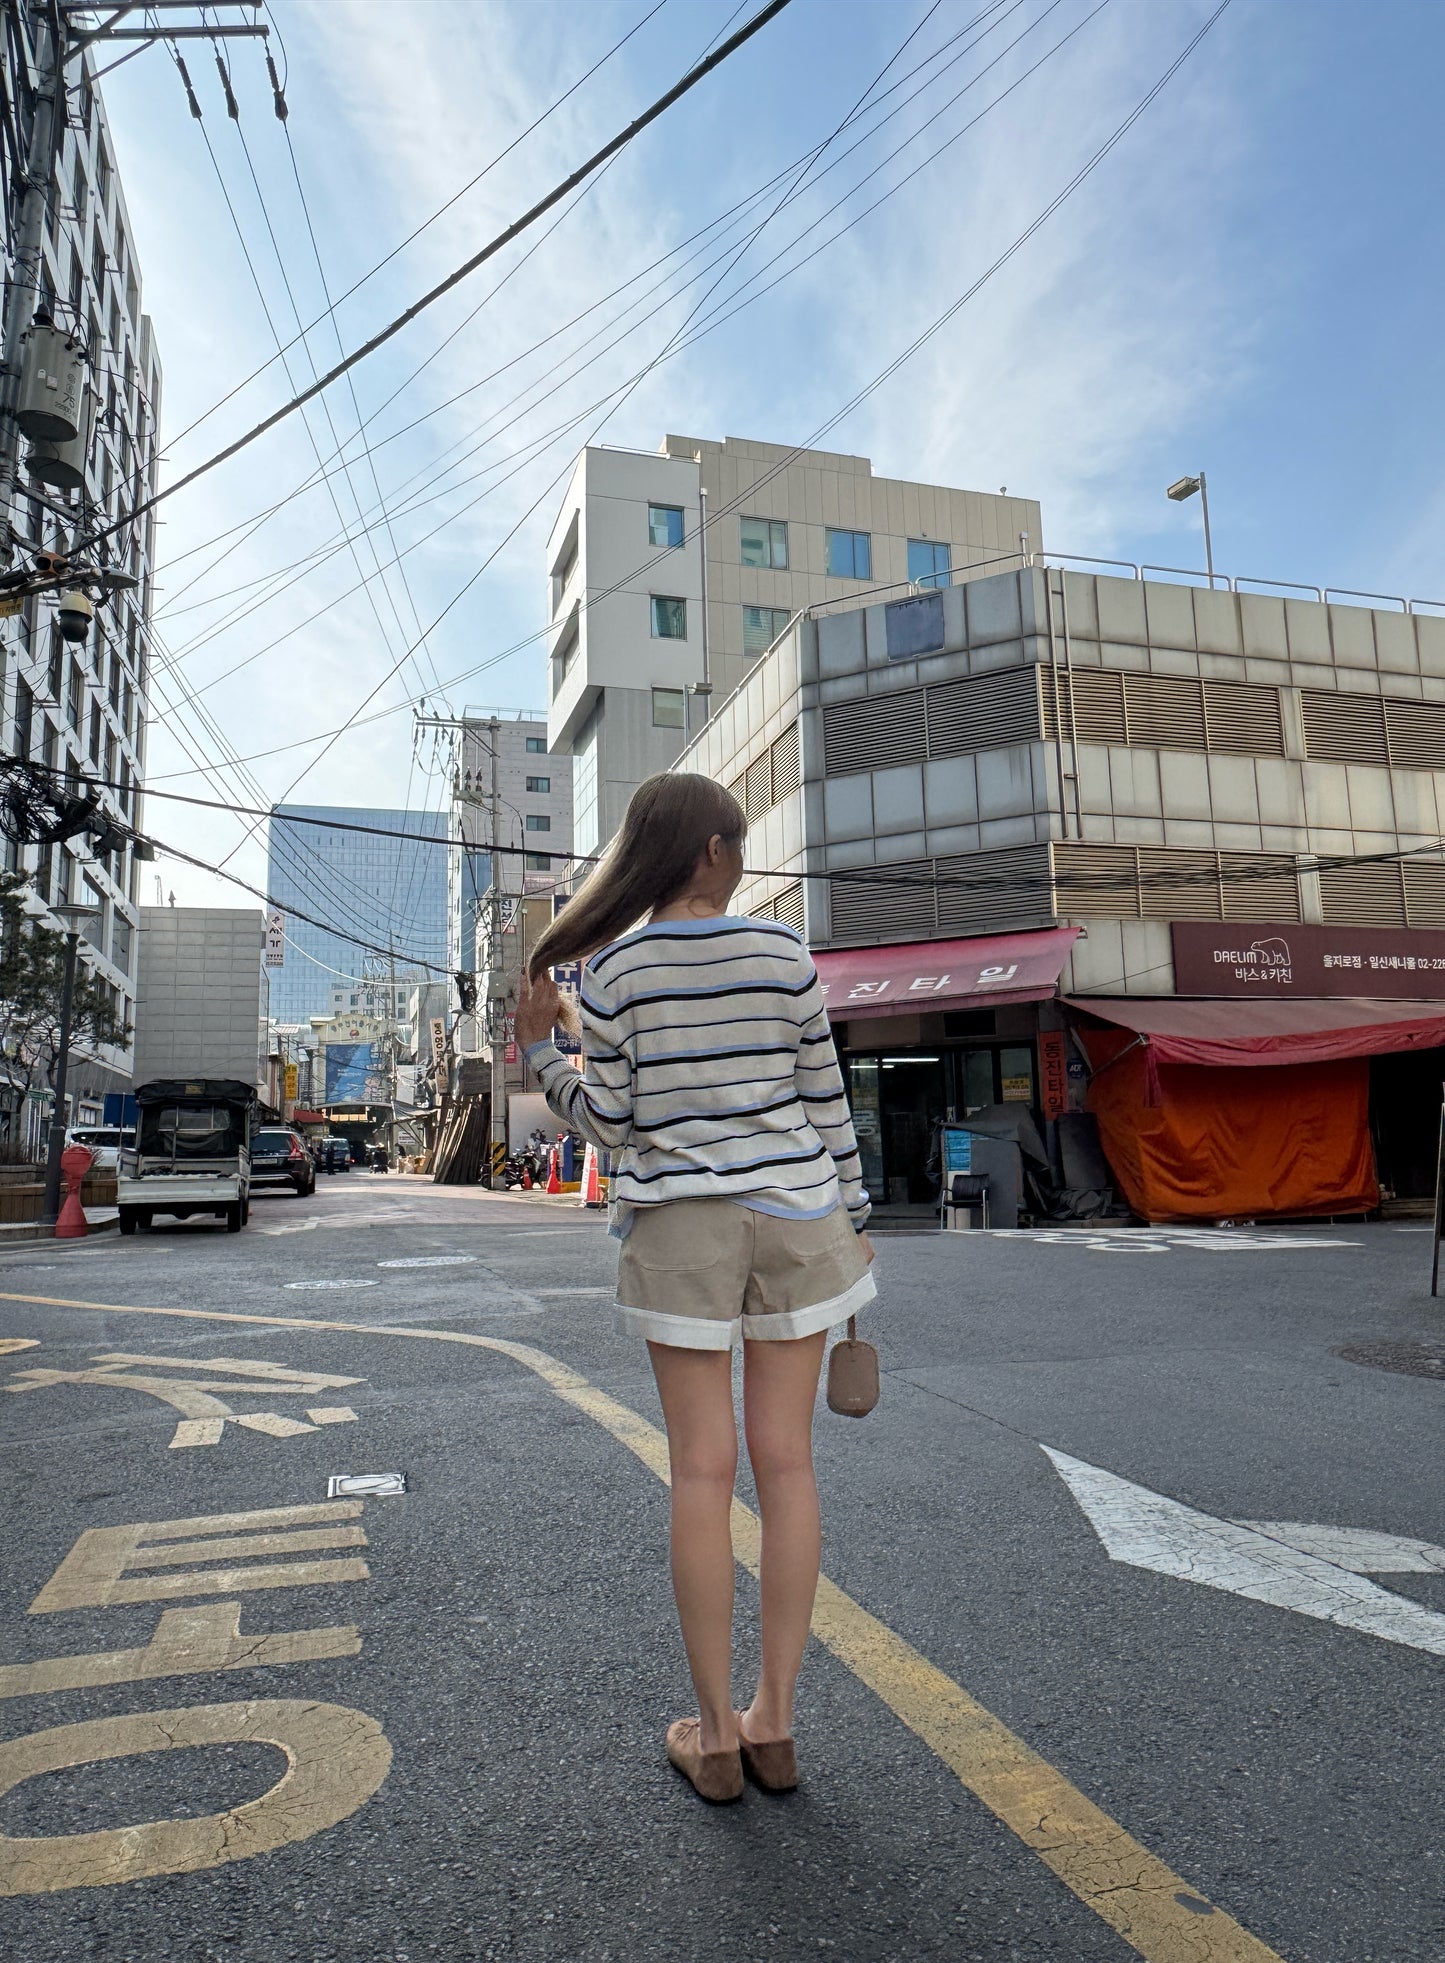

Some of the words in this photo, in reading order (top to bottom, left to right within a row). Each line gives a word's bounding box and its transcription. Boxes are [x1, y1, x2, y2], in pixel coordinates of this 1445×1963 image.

[1213, 950, 1257, 964] DAELIM
[1323, 954, 1361, 968] 을지로점
[820, 965, 1018, 999] 진타일
[1235, 968, 1293, 984] 바스&키친
[1044, 1041, 1065, 1112] 동진타일
